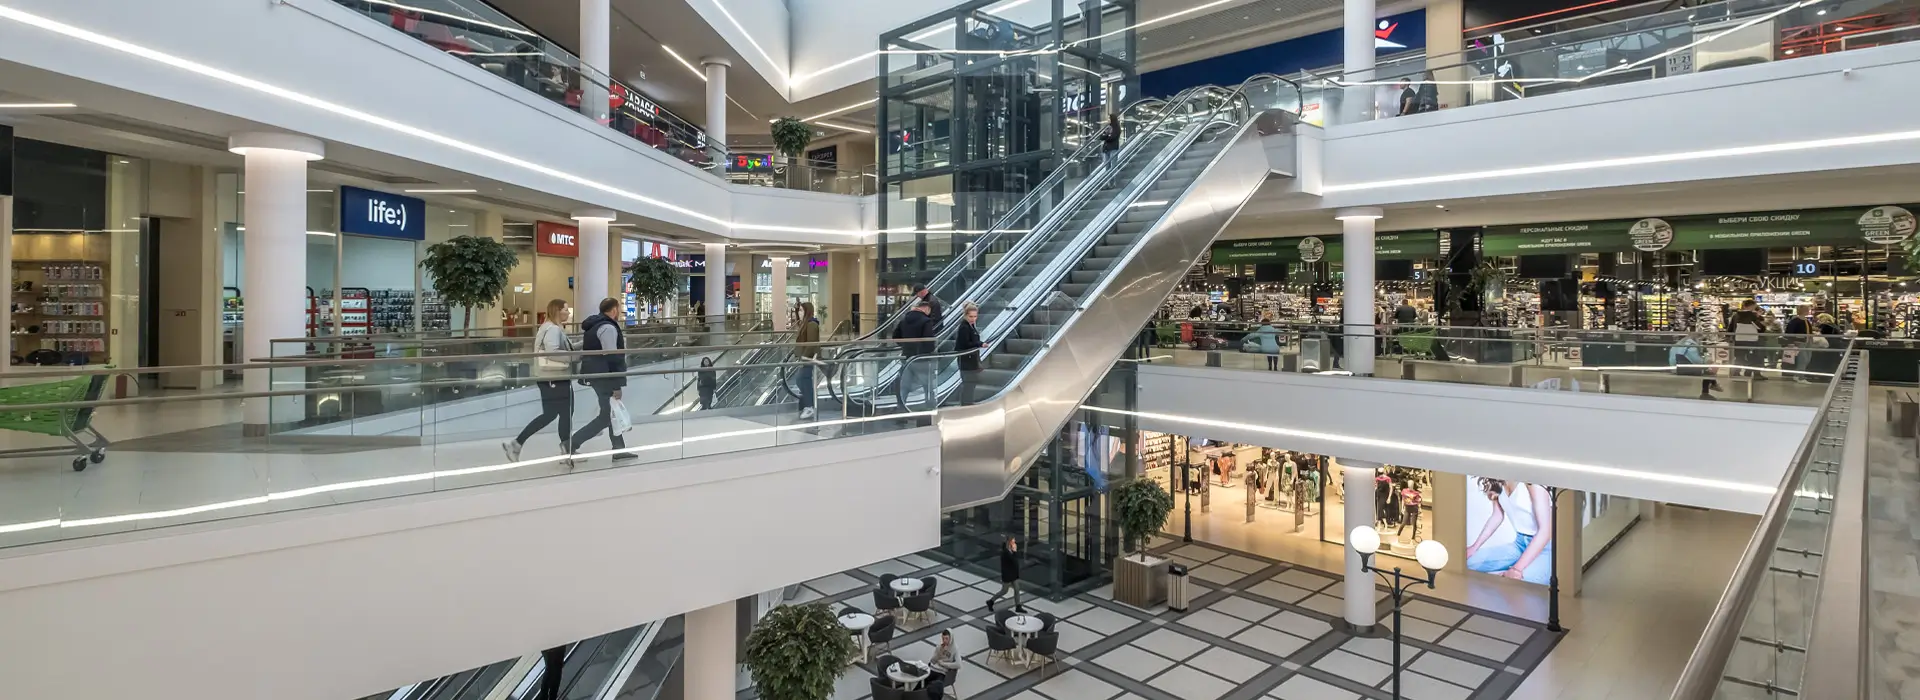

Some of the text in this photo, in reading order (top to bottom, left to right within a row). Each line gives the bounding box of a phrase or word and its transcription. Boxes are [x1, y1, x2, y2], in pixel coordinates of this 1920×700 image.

[368, 198, 407, 231] life:)
[1718, 216, 1748, 224] ВЫБЕРИ
[1770, 214, 1800, 222] СКИДКУ
[1796, 263, 1816, 274] 10
[1414, 271, 1421, 280] 5
